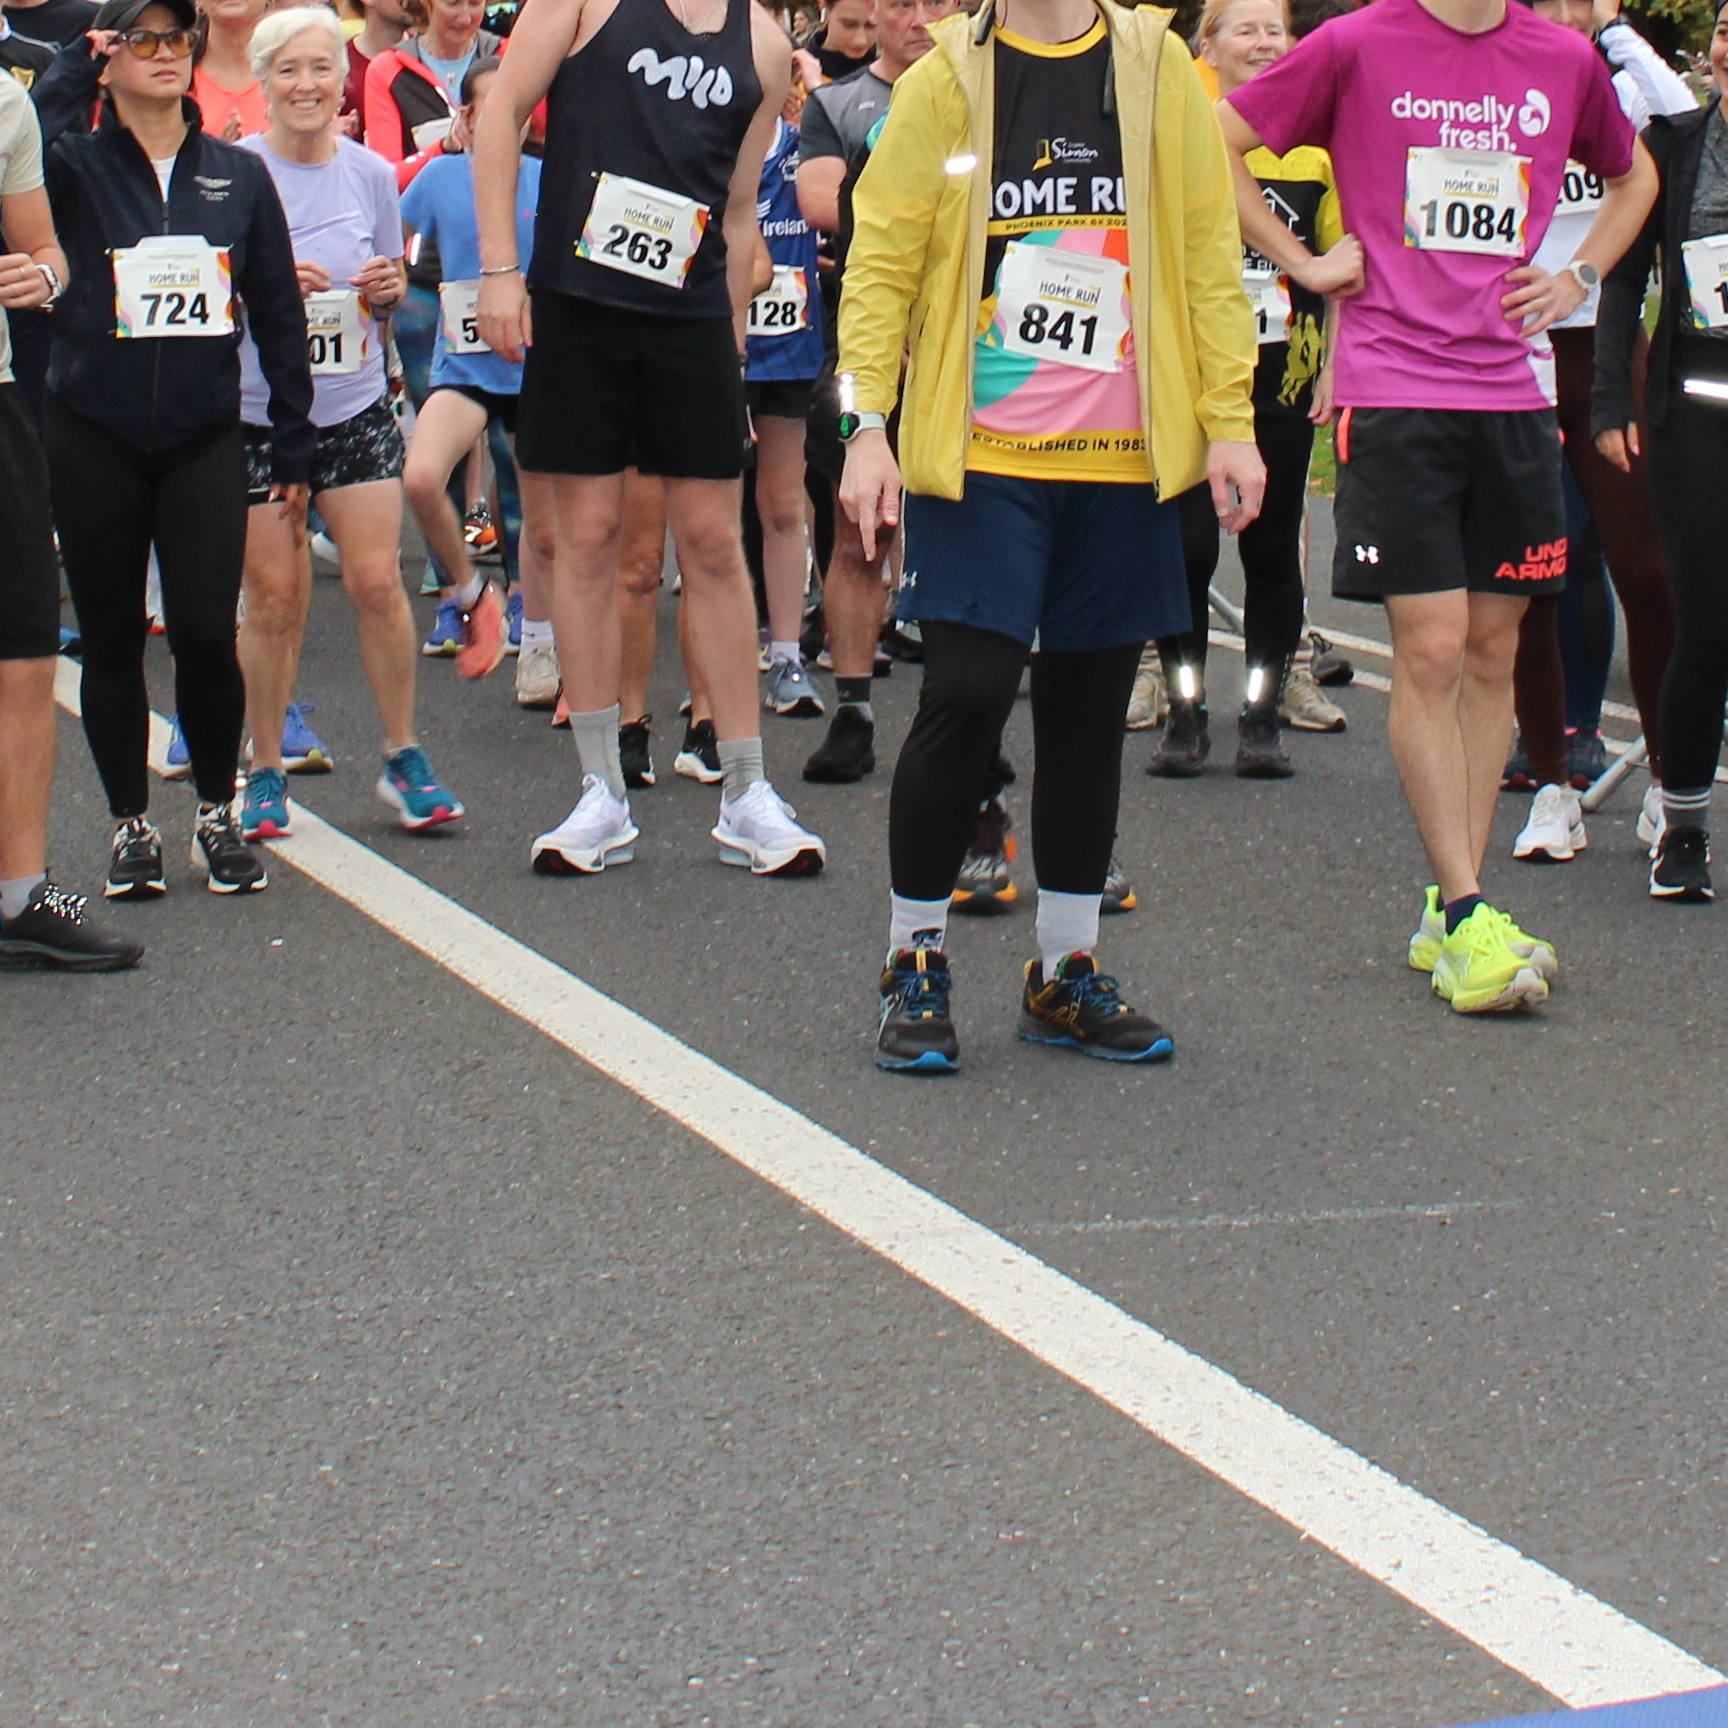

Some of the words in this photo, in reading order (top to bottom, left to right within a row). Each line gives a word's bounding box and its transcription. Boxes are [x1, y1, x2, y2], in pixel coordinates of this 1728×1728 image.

[1391, 90, 1516, 130] donnelly
[1051, 137, 1099, 160] Simon
[1438, 121, 1518, 152] fresh.
[1444, 179, 1475, 193] HOME
[1477, 178, 1500, 194] RUN
[1559, 171, 1605, 204] 09
[623, 206, 651, 223] HOME
[653, 216, 675, 231] RUN
[1005, 220, 1055, 231] PHOENIX
[1057, 219, 1087, 227] PARK
[1420, 199, 1516, 243] 1084
[601, 223, 673, 270] 263
[148, 272, 177, 285] HOME
[179, 269, 200, 283] RUN
[1039, 280, 1074, 298] HOME
[1075, 286, 1101, 305] RUN
[140, 292, 210, 327] 724
[1019, 302, 1100, 355] 841
[1092, 439, 1109, 451] IN
